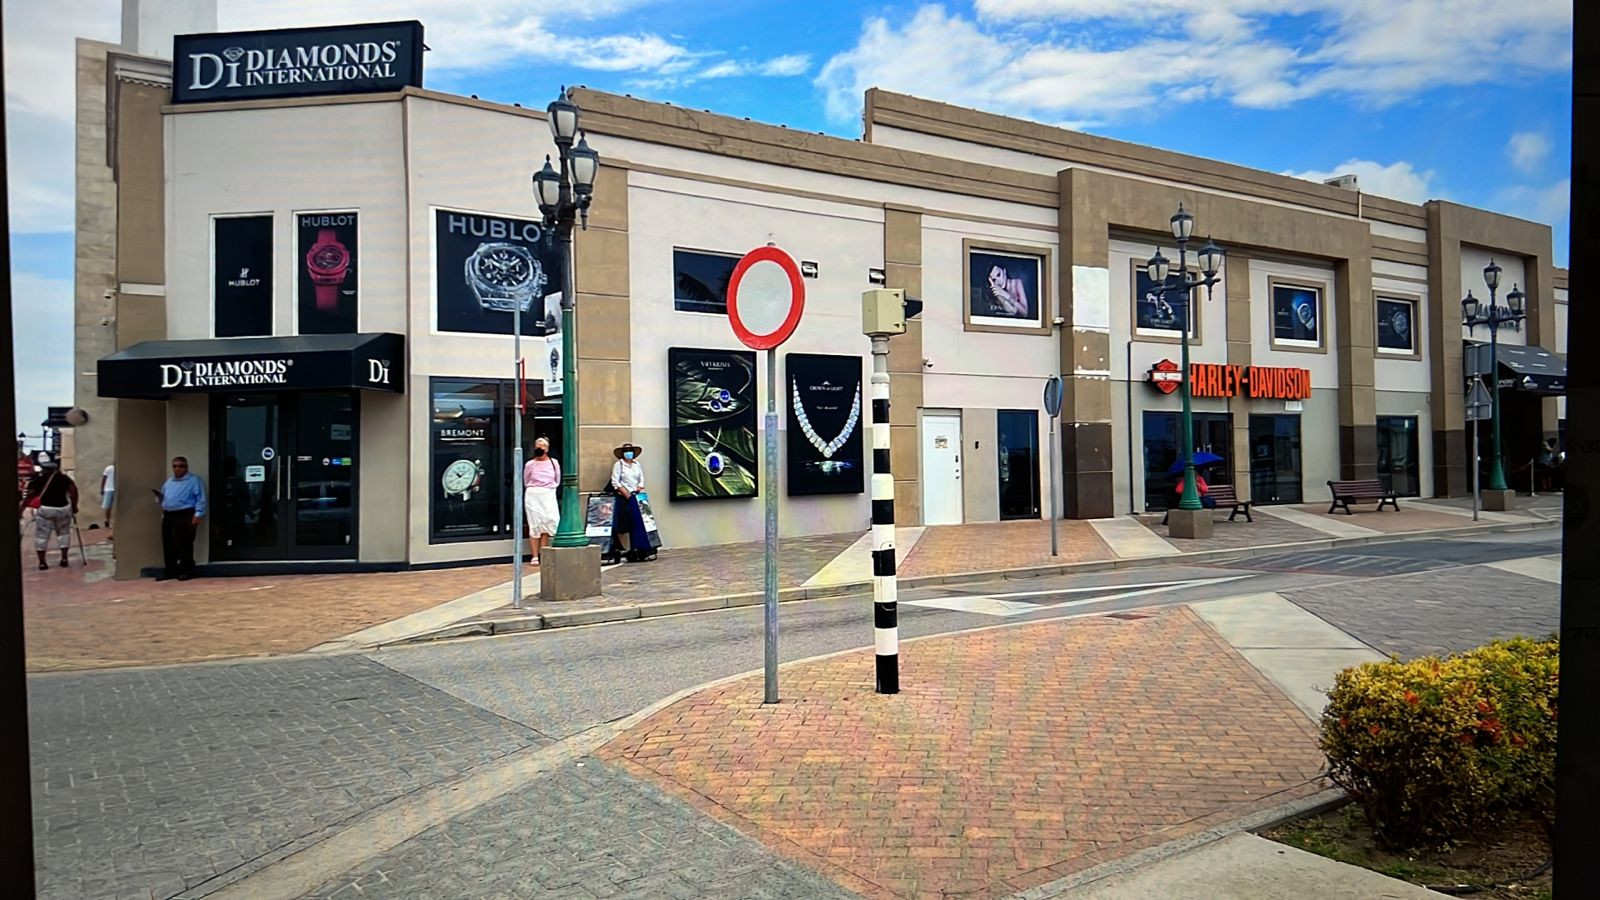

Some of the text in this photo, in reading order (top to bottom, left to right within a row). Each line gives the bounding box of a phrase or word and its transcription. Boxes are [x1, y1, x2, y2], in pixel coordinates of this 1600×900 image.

[245, 41, 397, 71] DIAMONDS
[246, 63, 396, 87] INTERNATIONAL
[301, 215, 355, 227] HUBLOT
[449, 214, 542, 243] HUBLO
[228, 279, 261, 287] HUBLOT
[195, 359, 287, 377] DIAMONDS
[367, 358, 390, 384] Di
[195, 373, 287, 387] INTERNATIONAL
[1189, 363, 1311, 400] HARLEY-DAVIDSON
[440, 429, 485, 437] BREMONT
